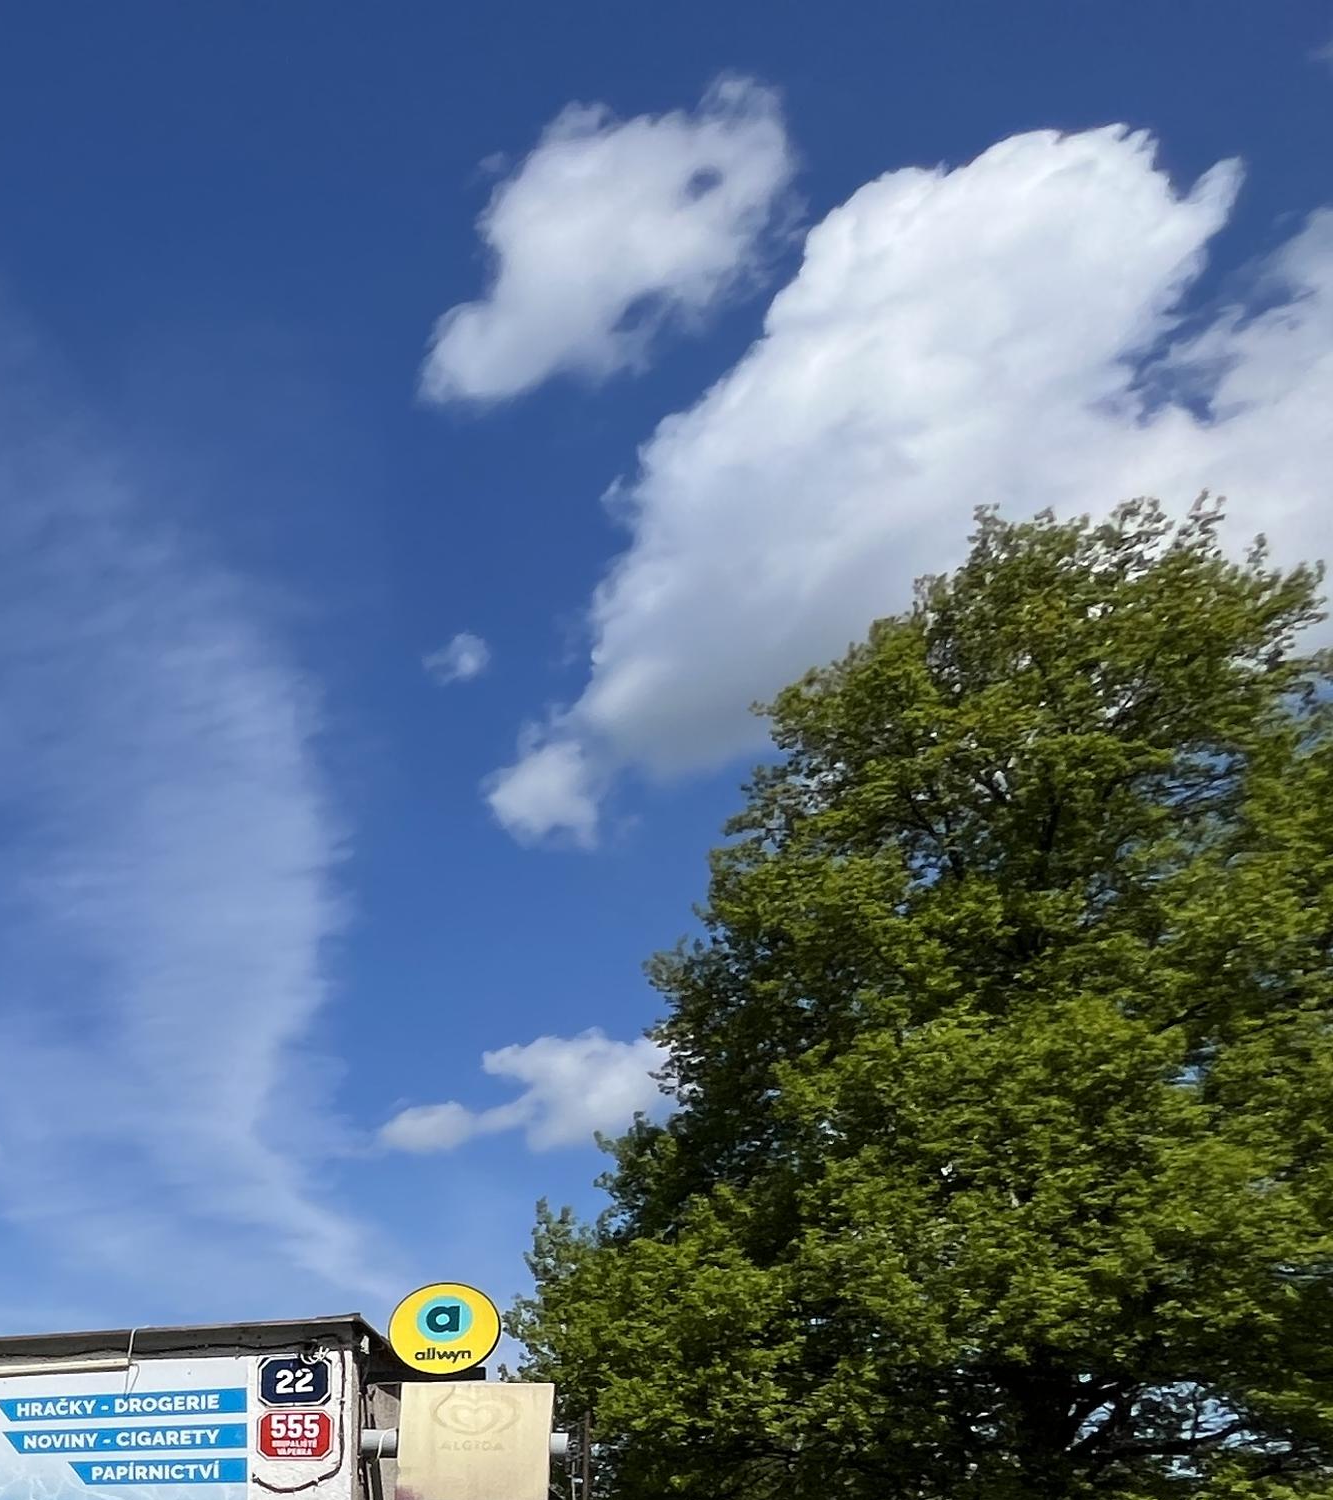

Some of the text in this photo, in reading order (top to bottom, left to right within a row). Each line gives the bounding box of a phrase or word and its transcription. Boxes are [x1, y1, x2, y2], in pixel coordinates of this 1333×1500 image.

[415, 1348, 471, 1363] allwyn
[276, 1368, 313, 1393] 22
[16, 1398, 96, 1417] HRAČKY
[114, 1394, 220, 1414] DROGERIE
[271, 1414, 320, 1438] 555
[23, 1432, 98, 1449] NOVINY
[116, 1429, 220, 1446] CIGARETY
[91, 1461, 220, 1480] PAPÍRNICTVÍ
